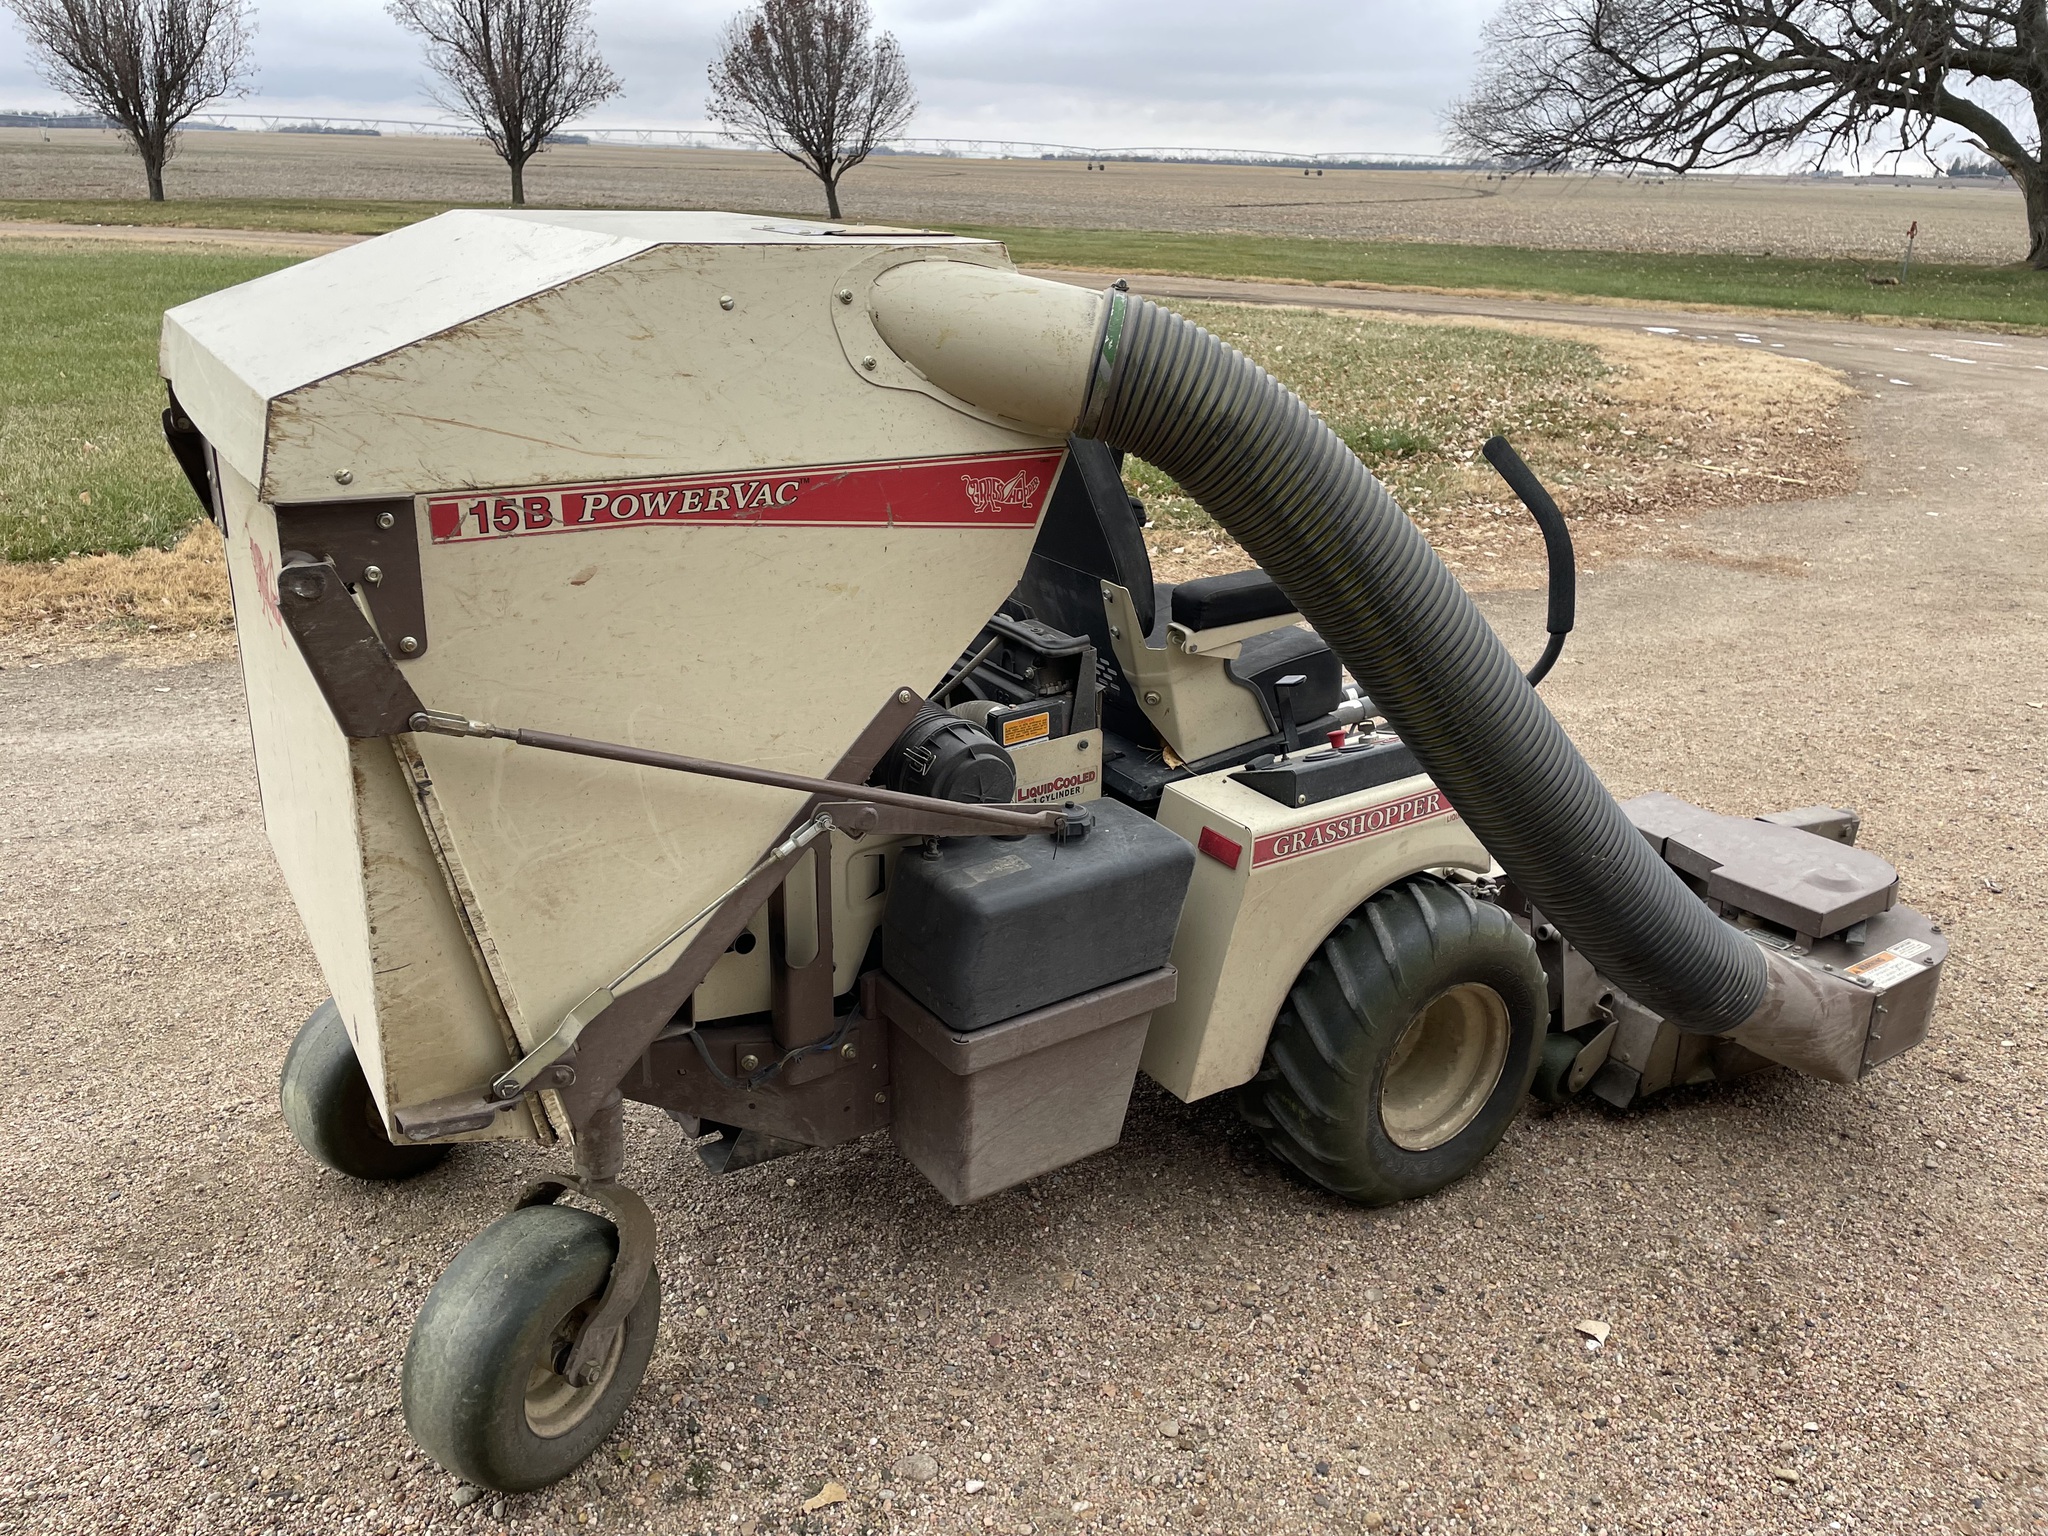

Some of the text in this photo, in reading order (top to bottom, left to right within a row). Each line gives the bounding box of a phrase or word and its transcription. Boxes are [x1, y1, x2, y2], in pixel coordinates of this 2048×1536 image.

[469, 496, 553, 534] 15B
[1039, 785, 1081, 804] CYLINDER
[1272, 792, 1440, 857] GRASSHOPPER
